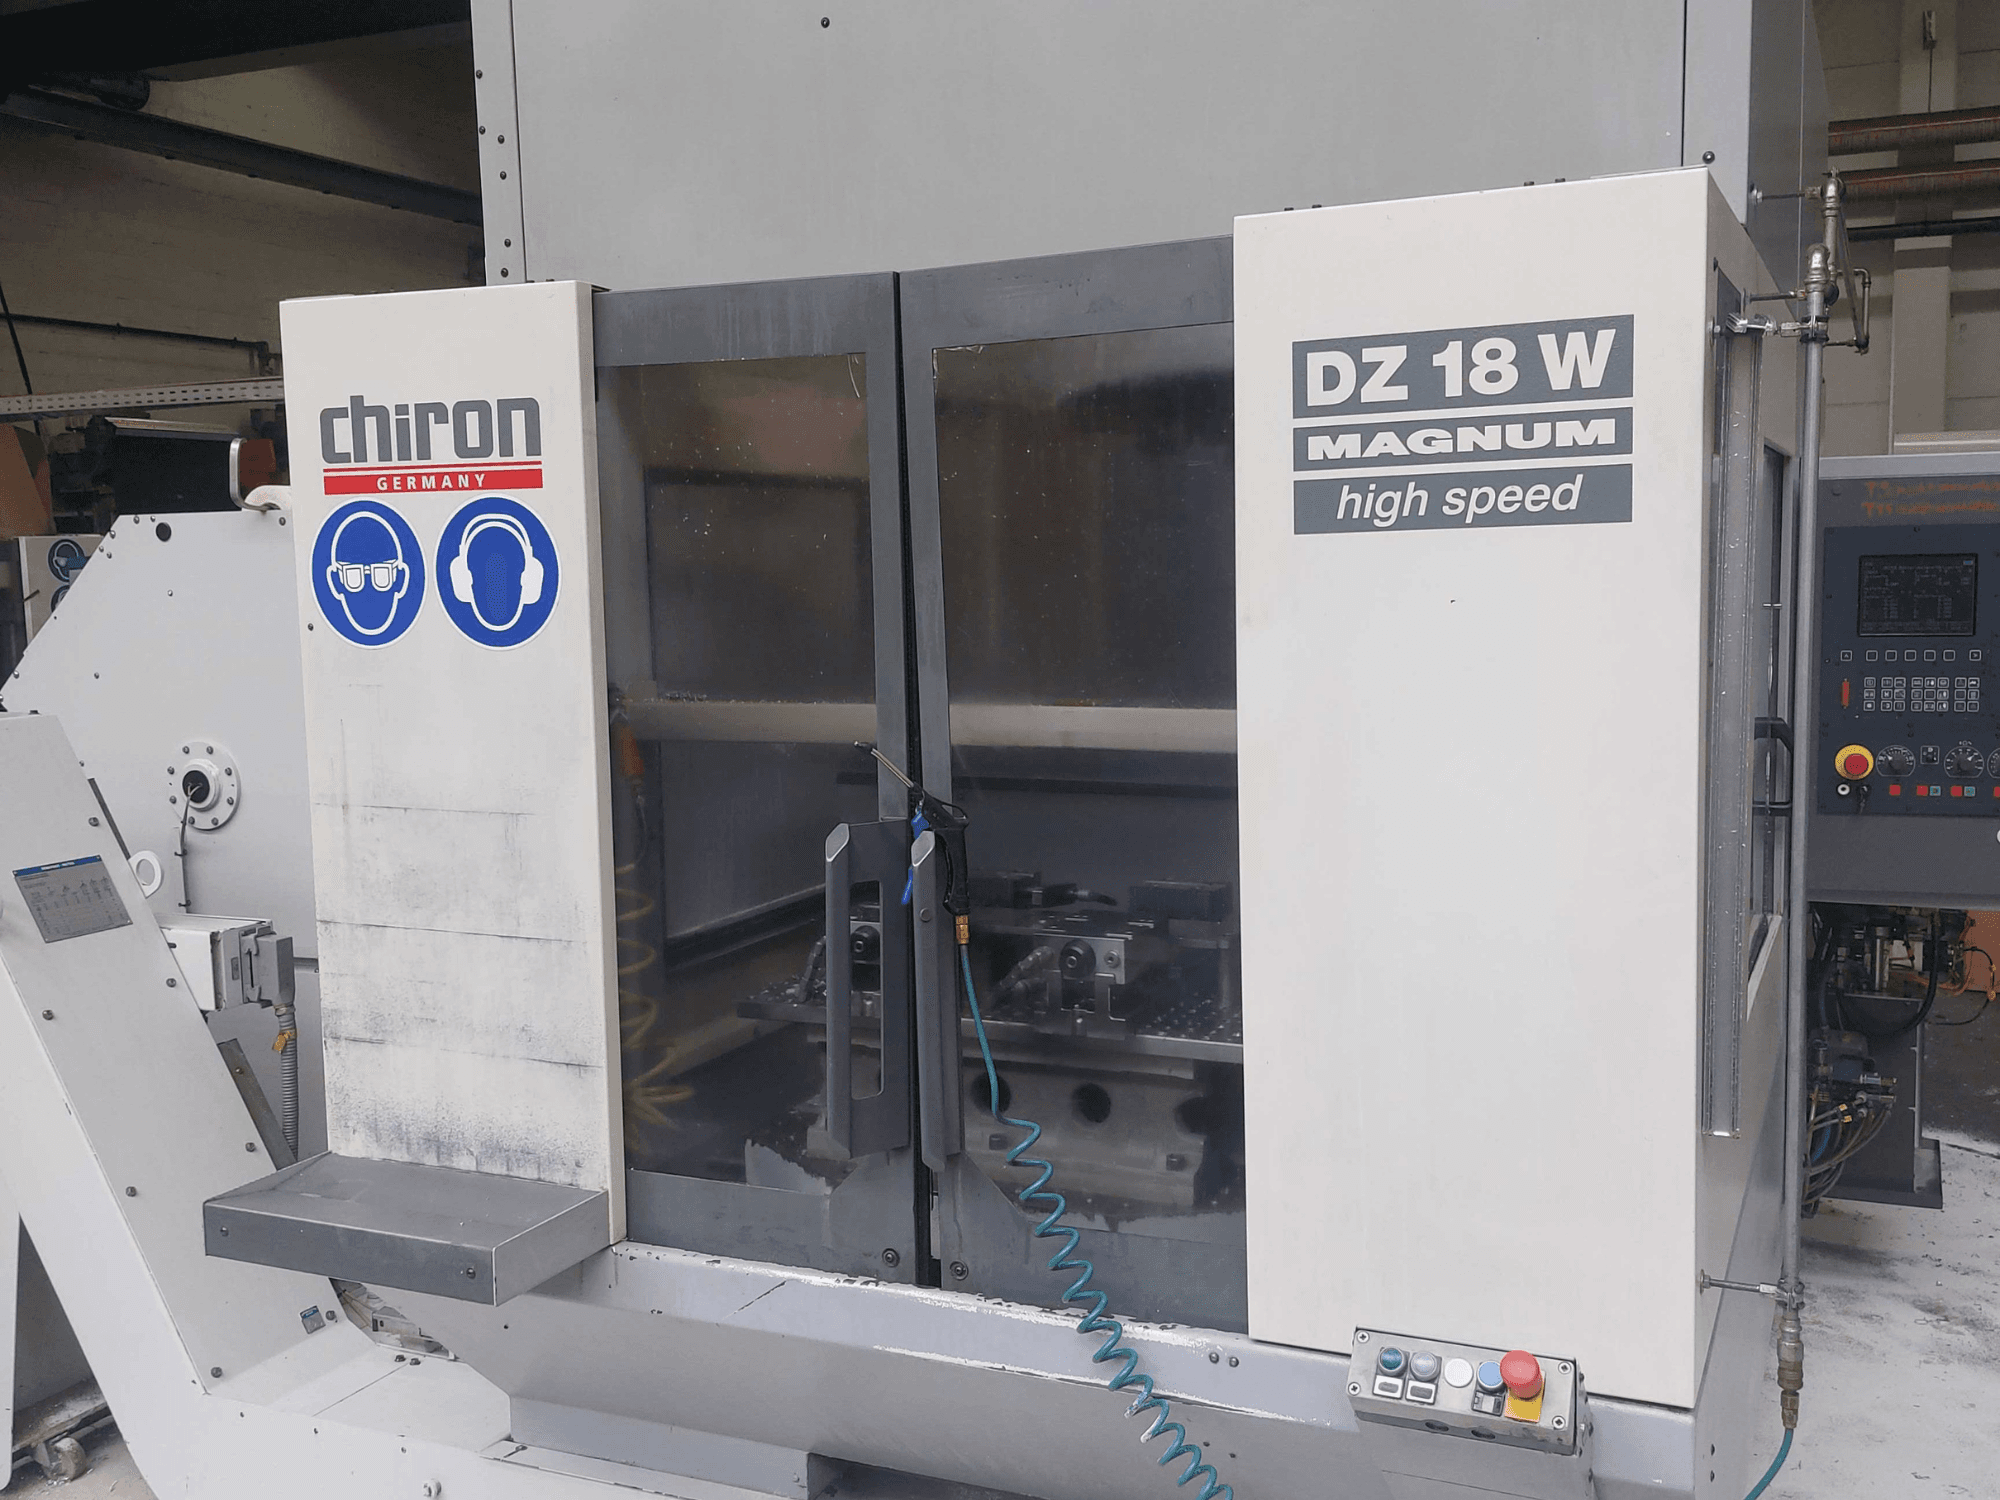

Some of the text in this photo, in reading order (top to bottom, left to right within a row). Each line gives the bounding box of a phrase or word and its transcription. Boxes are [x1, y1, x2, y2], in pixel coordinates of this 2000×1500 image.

[1306, 328, 1617, 407] DZ 18 W
[319, 395, 542, 464] chiron
[1307, 417, 1616, 461] MAGNUM
[376, 473, 486, 491] GERMANY
[1336, 473, 1584, 527] high speed
